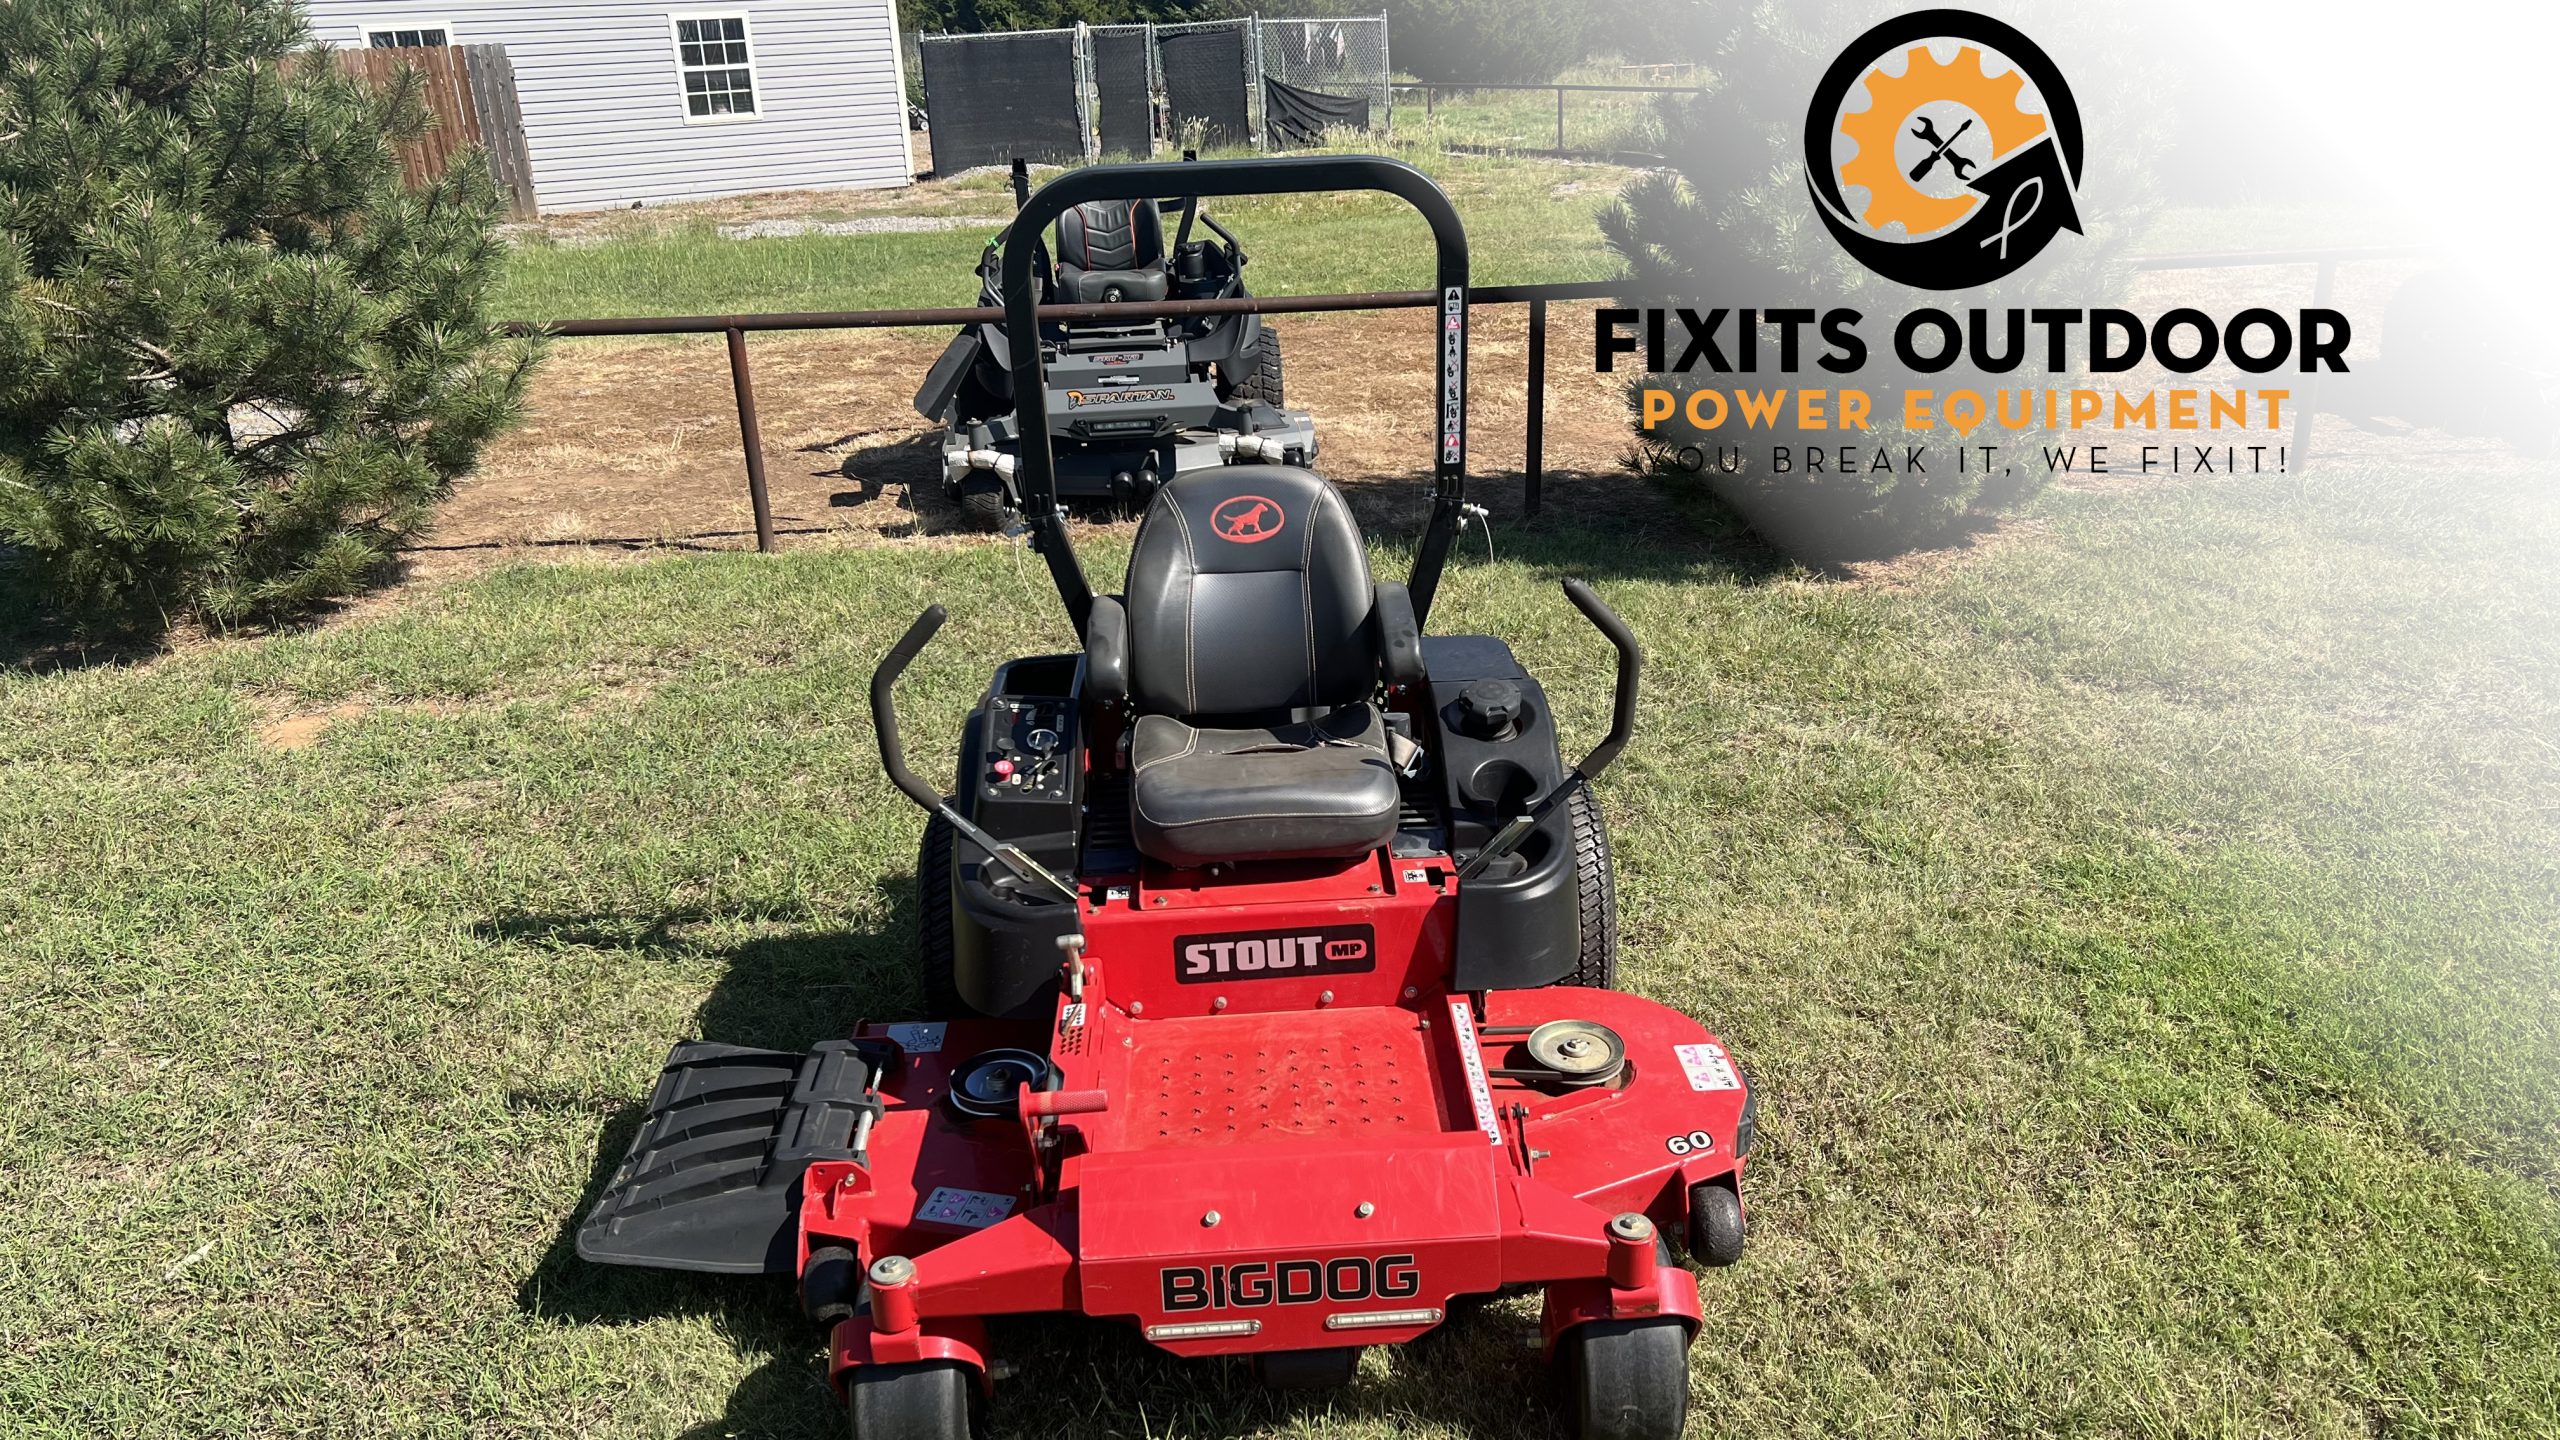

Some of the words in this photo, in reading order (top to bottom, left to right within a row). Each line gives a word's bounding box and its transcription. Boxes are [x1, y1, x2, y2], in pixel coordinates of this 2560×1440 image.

[1185, 936, 1323, 975] STOUT
[1331, 943, 1362, 957] MP
[1665, 1130, 1713, 1156] 60
[1160, 1253, 1420, 1313] BIGDOG
